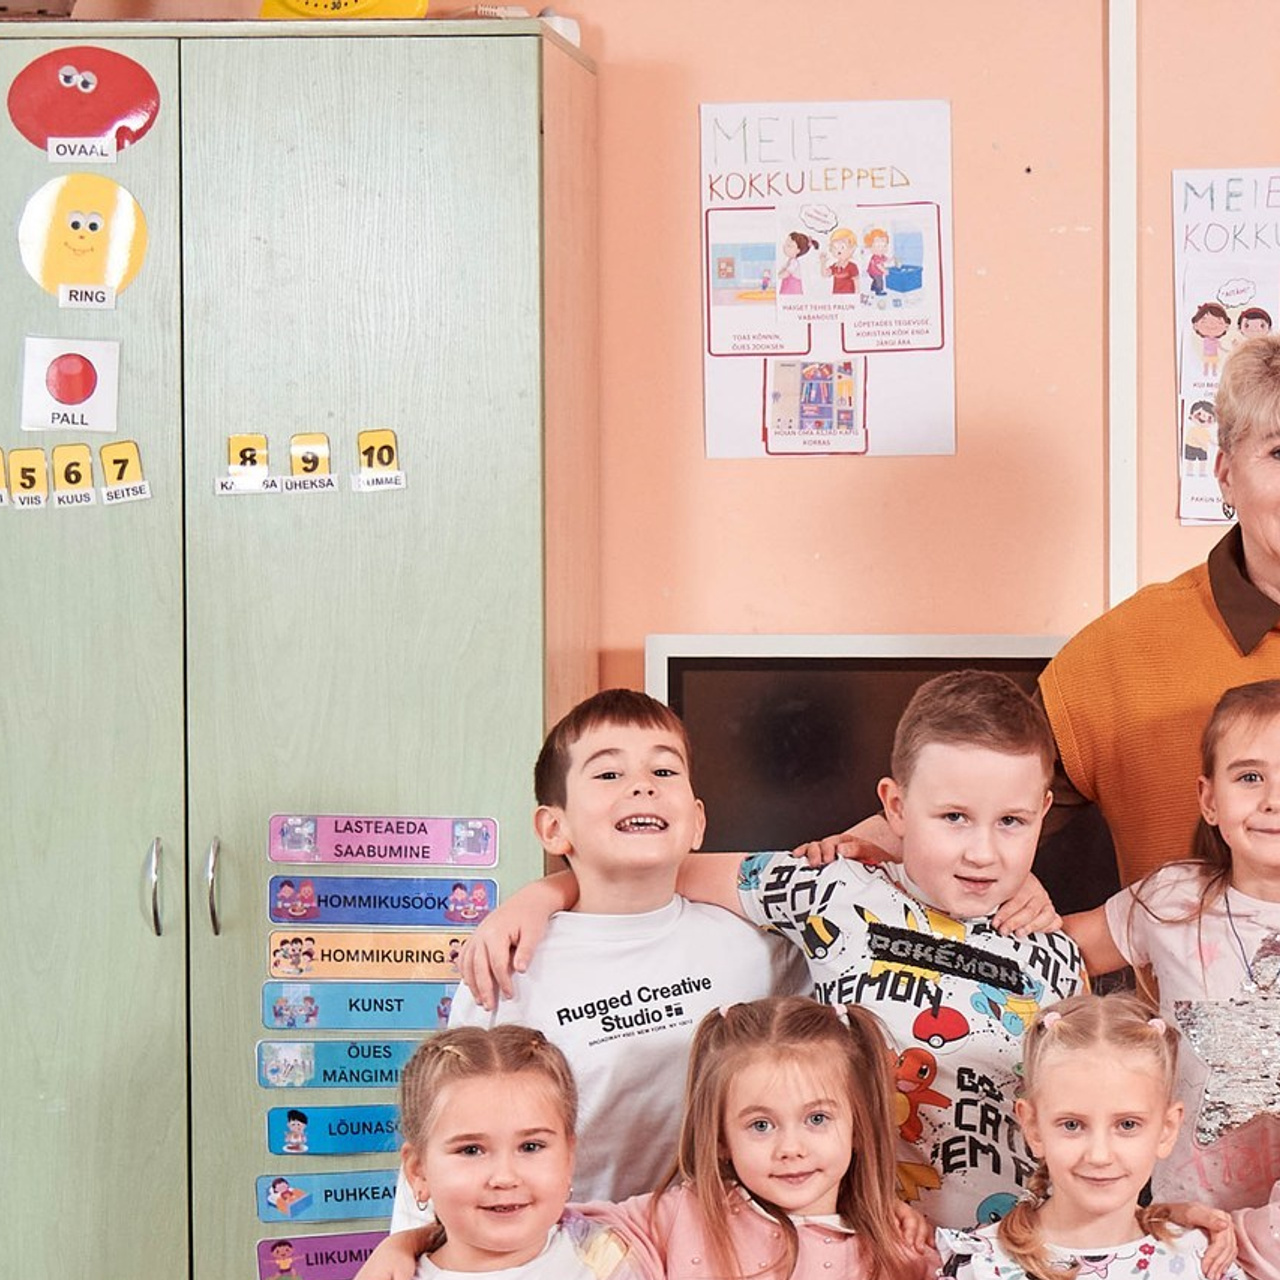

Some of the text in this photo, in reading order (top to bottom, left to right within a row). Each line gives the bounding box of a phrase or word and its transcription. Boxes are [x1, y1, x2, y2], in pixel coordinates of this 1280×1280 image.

[713, 115, 838, 165] MEIE
[55, 143, 108, 158] OVAAL
[708, 165, 910, 201] KOKKULEPPED
[68, 289, 106, 304] RING
[50, 412, 89, 426] PALL
[301, 452, 320, 473] 9
[361, 445, 395, 468] 10
[64, 461, 82, 485] 6
[113, 458, 129, 480] 7
[20, 466, 36, 490] 5
[18, 495, 42, 506] VIIS
[57, 493, 91, 506] KUUS
[106, 485, 146, 501] SEITSE
[334, 820, 428, 835] LASTEAEDA
[334, 845, 431, 859] SAABUMINE
[317, 892, 449, 910] HOMMIKUSÖÖK
[320, 949, 445, 963] HOMMIKURING
[868, 931, 1021, 988] POKÉMON
[348, 998, 404, 1012] KUNST
[556, 976, 712, 1026] Rugged Creative
[601, 1008, 663, 1033] Studio
[347, 1042, 392, 1059] ÕUES
[322, 1066, 399, 1083] MÄNGIMI
